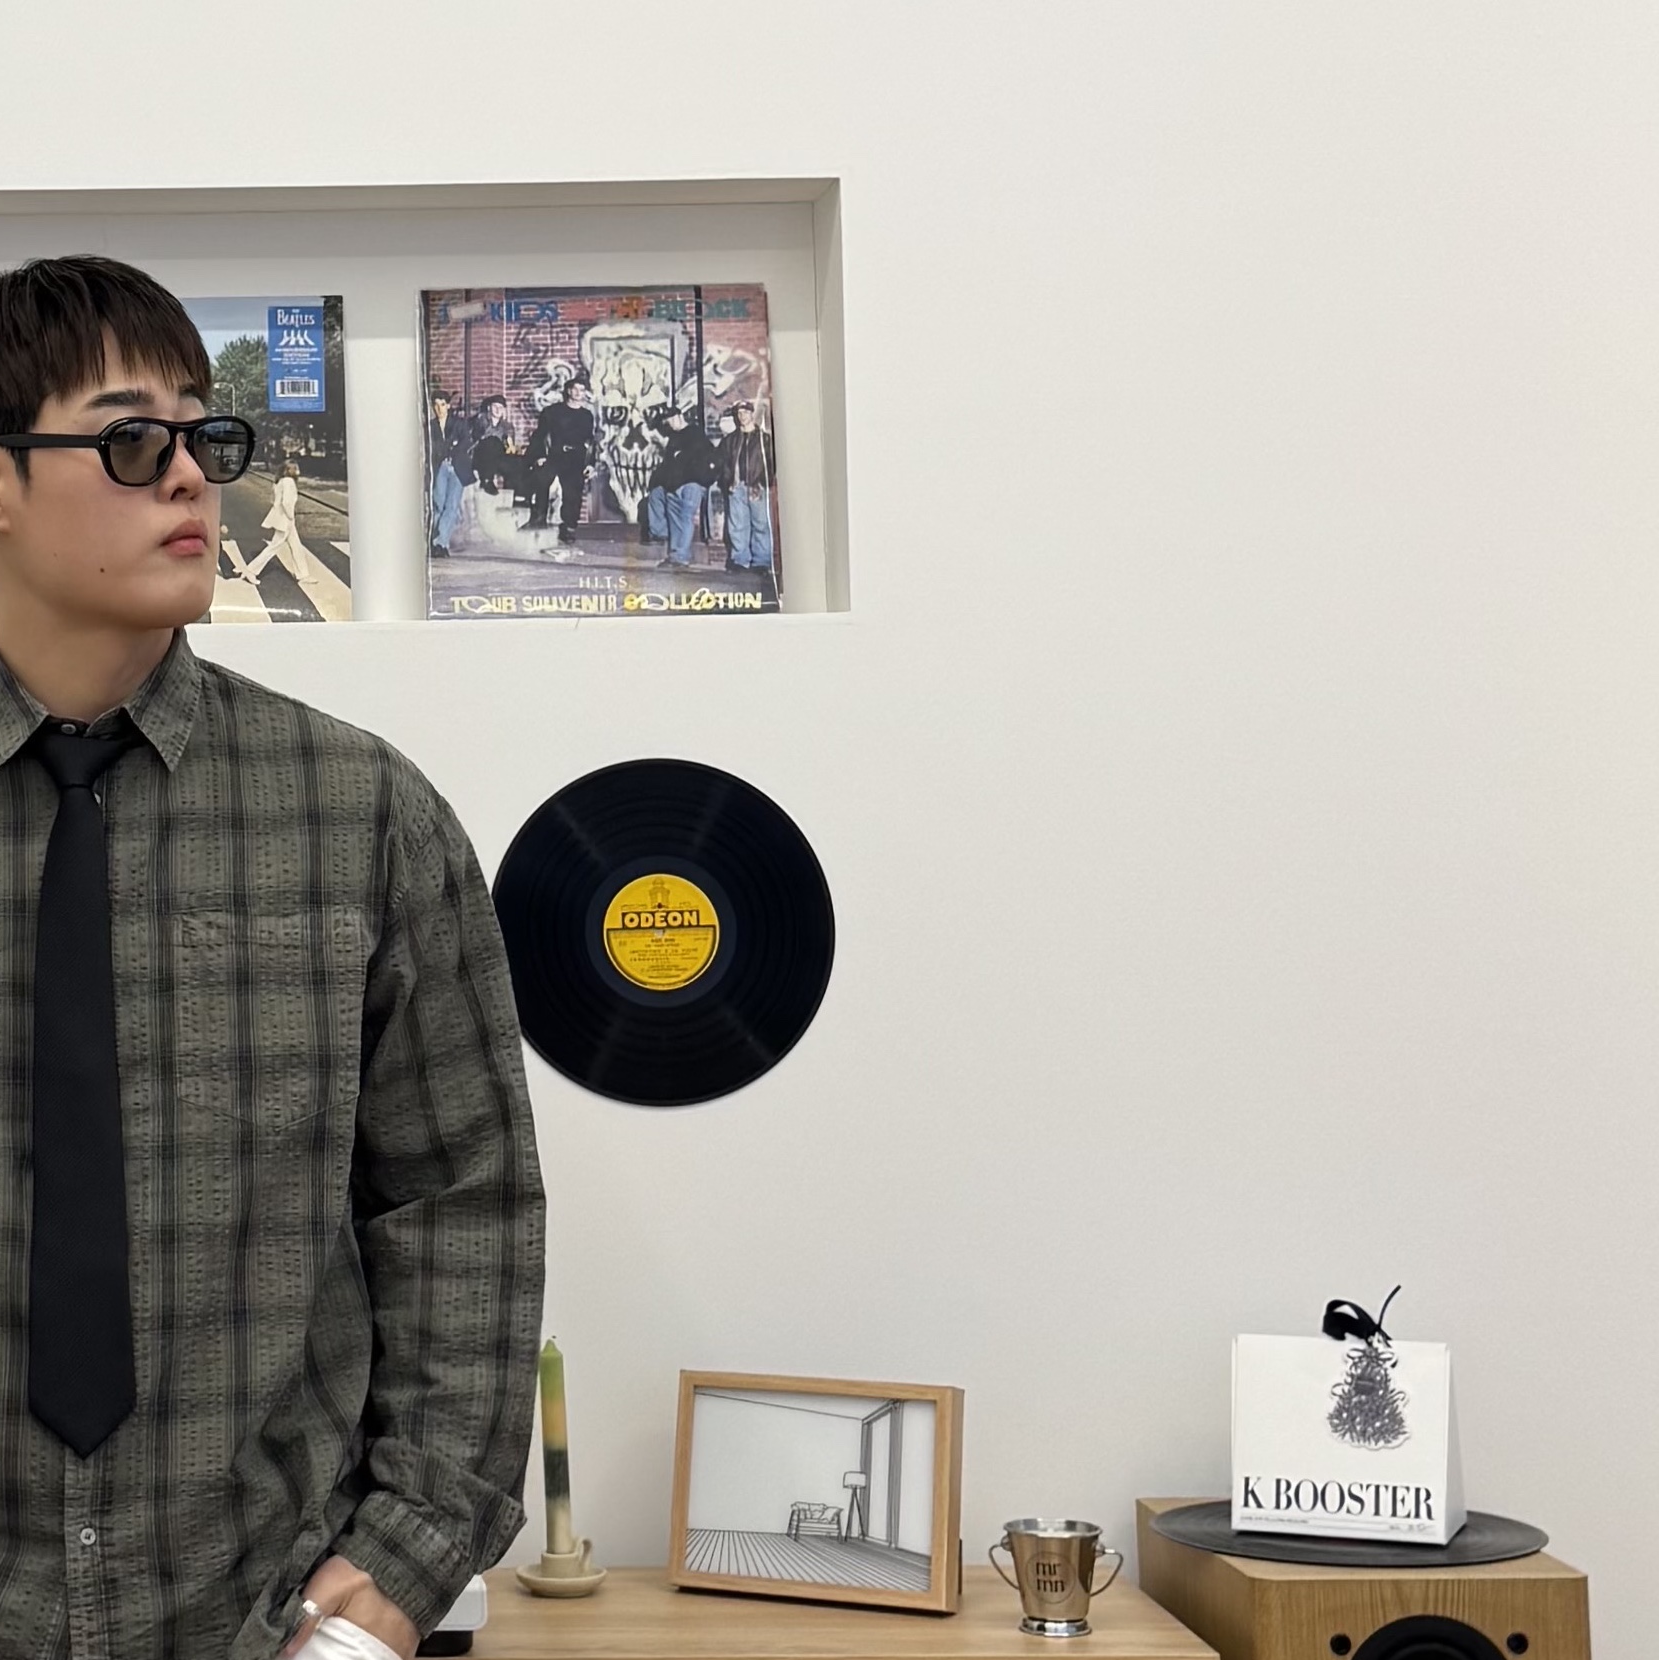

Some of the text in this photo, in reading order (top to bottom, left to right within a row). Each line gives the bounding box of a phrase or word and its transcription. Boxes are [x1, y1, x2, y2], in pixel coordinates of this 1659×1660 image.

[624, 911, 698, 928] ODEON
[1241, 1476, 1435, 1521] K BOOSTER
